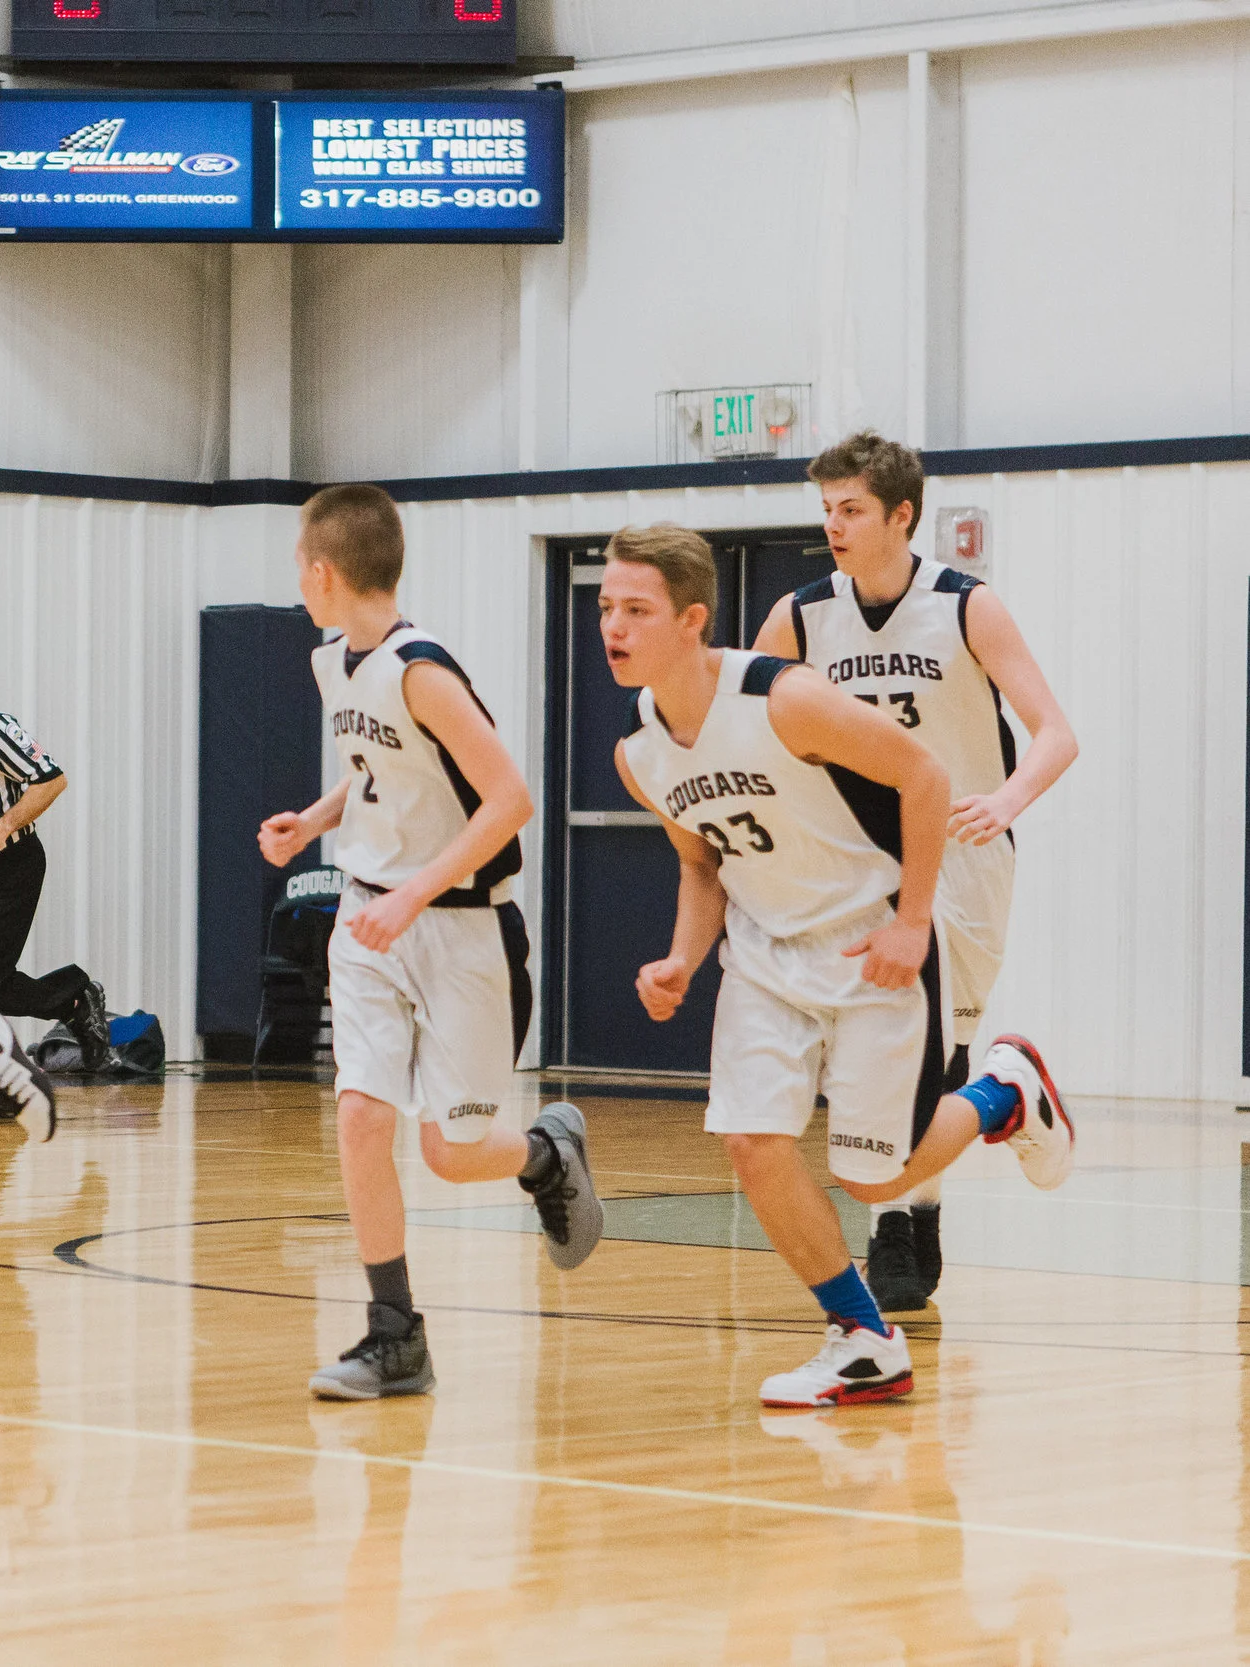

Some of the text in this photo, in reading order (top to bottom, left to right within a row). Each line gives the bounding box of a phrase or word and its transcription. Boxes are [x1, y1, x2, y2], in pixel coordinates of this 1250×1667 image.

[313, 119, 526, 137] BEST SELECTIONS
[313, 139, 527, 159] LOWEST PRICES
[42, 151, 182, 170] SKILLMAN
[193, 157, 227, 172] Ford
[313, 161, 526, 175] WORLD CLASS SERVICE
[21, 193, 49, 203] U.S.
[53, 193, 70, 203] 31
[74, 193, 132, 204] SOUTH,
[135, 194, 239, 204] GREENWOOD
[300, 188, 541, 208] 317-885-9800
[714, 394, 754, 436] EXIT
[828, 653, 943, 684] COUGARS
[351, 754, 378, 803] 2
[665, 771, 776, 820] COUGARS
[698, 811, 774, 857] 23
[830, 1133, 894, 1156] COUGARS
